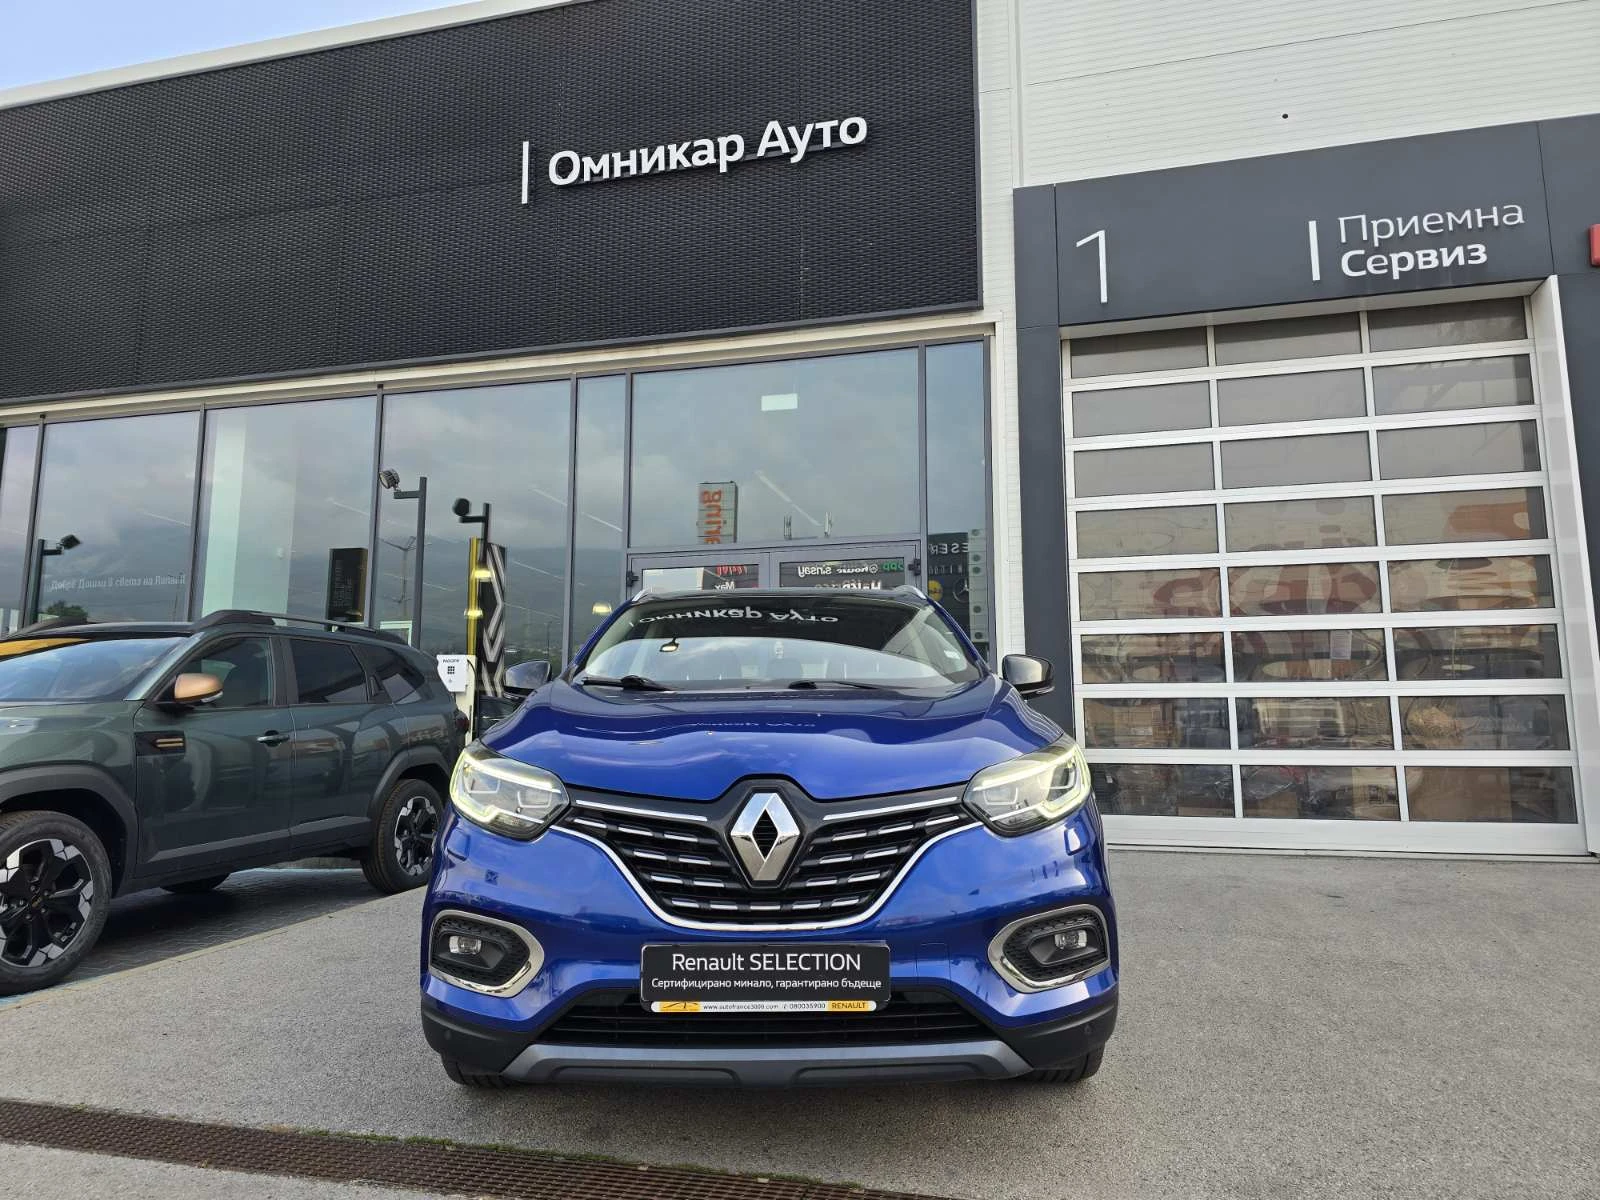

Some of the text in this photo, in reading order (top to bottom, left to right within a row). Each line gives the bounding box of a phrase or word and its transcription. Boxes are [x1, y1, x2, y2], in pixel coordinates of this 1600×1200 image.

[549, 116, 867, 186] Омникар Ауто
[1338, 204, 1525, 246] Приемна
[1076, 230, 1108, 304] 1
[1341, 243, 1488, 279] Сервиз
[672, 953, 861, 971] Renault SELECTION
[651, 977, 882, 990] Сертифицирано минало, гарантирано бъдеще
[831, 1001, 867, 1010] RENAULT
